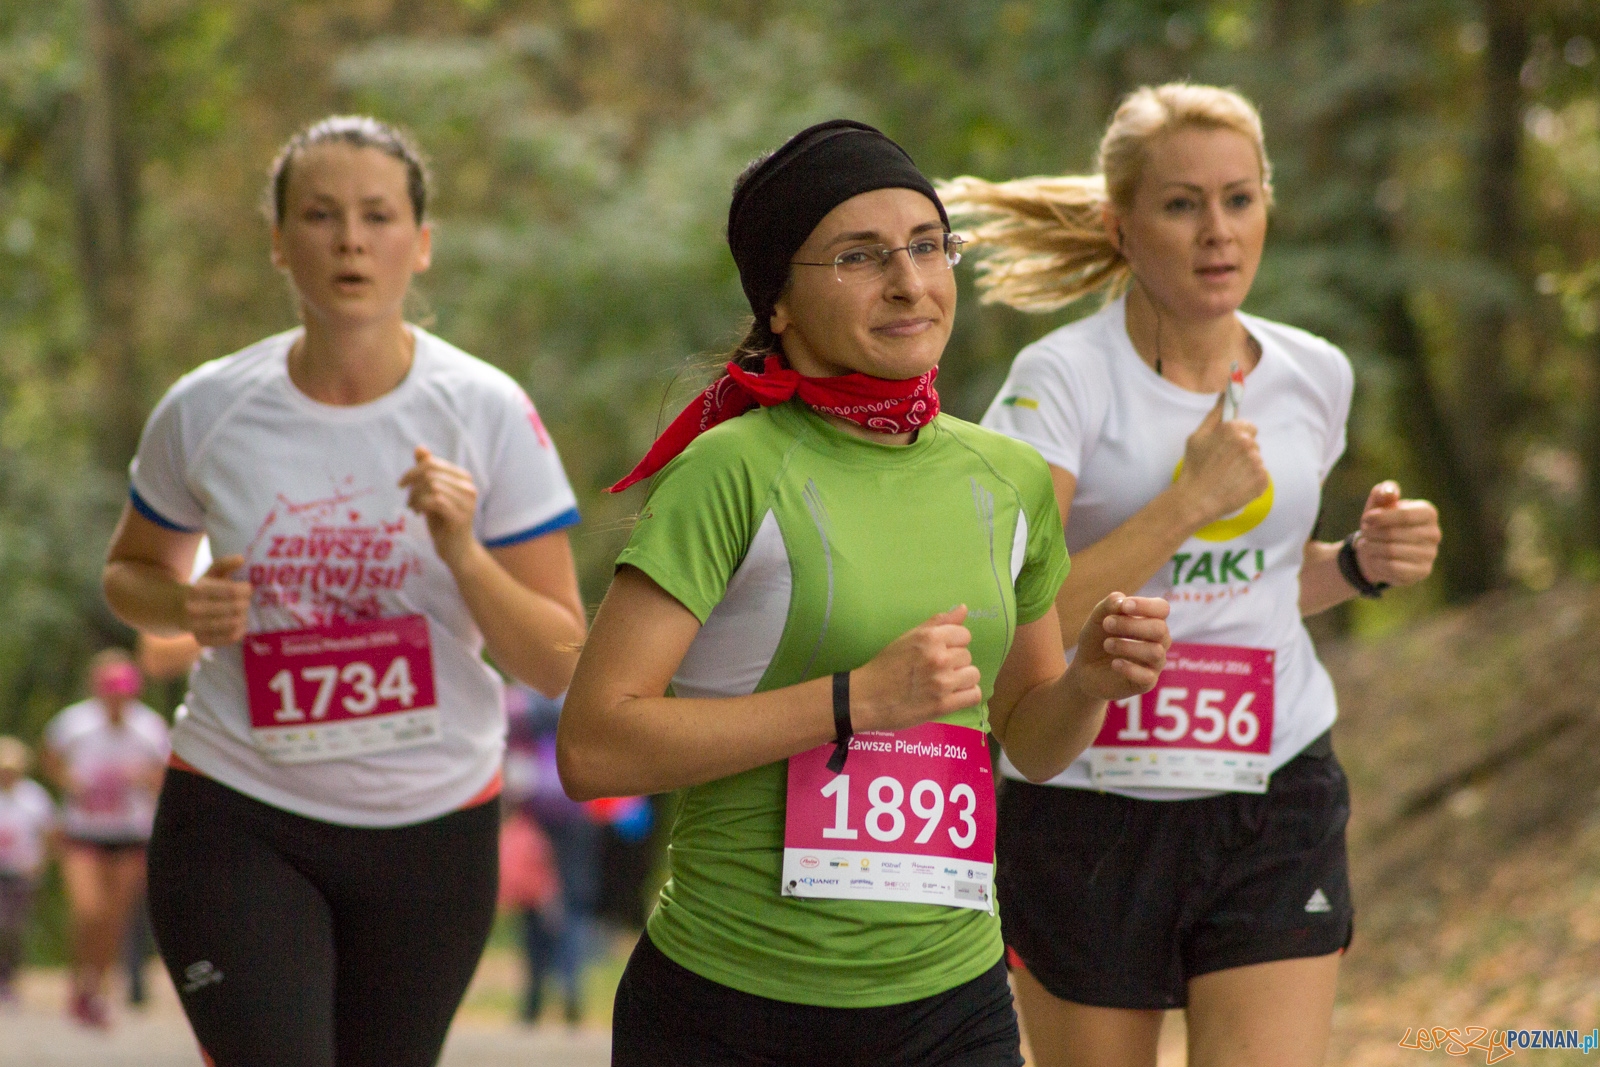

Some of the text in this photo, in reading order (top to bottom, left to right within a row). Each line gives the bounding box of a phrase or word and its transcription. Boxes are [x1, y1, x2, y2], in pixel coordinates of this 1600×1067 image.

[267, 535, 394, 561] zawsze
[268, 656, 418, 721] 1734
[1115, 687, 1260, 747] 1556
[847, 737, 968, 760] Zawsze Pier(w)si 2016
[820, 774, 977, 849] 1893
